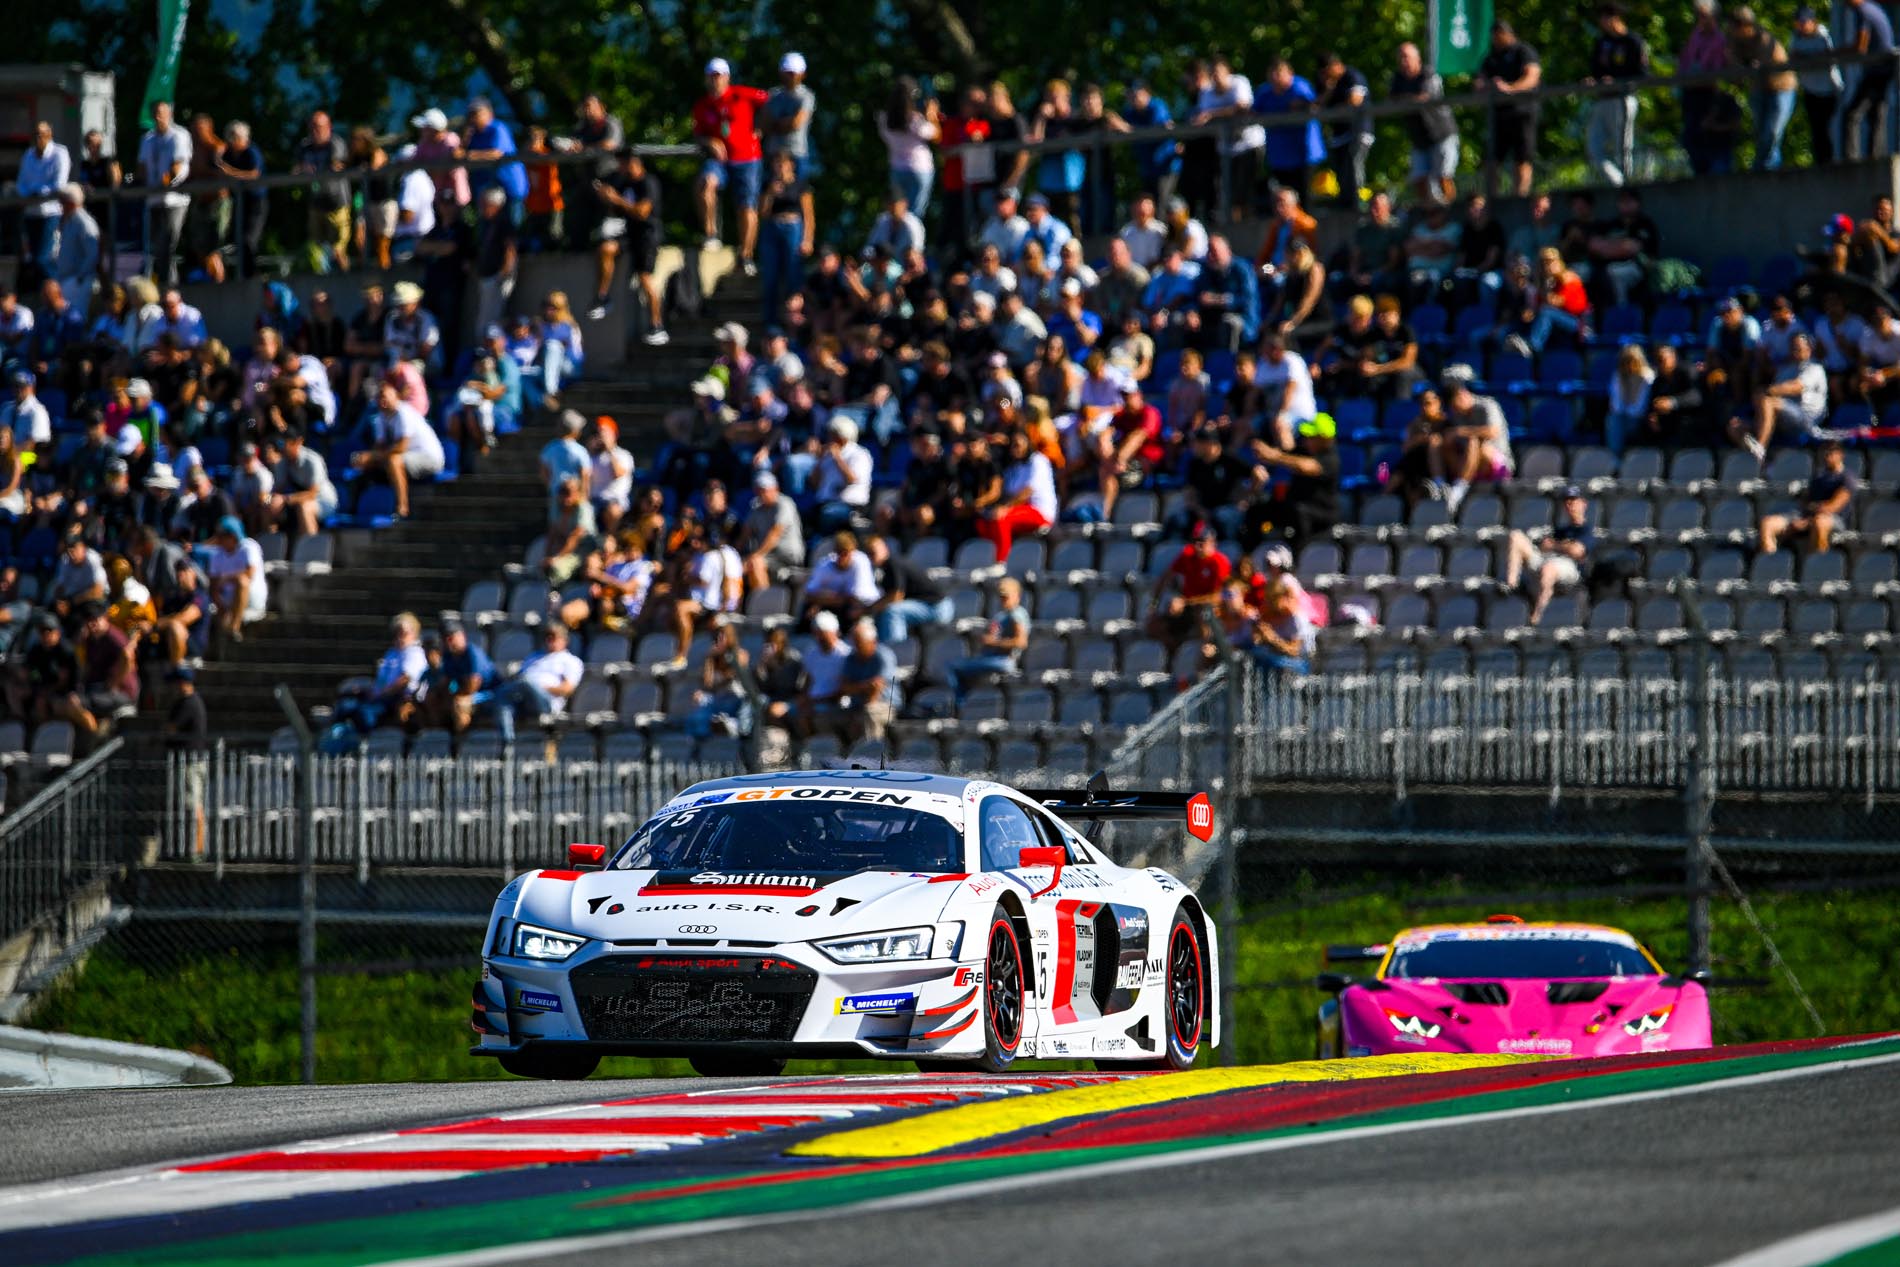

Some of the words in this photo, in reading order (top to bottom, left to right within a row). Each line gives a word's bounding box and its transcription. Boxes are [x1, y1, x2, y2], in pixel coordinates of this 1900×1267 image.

[635, 903, 698, 913] auto
[962, 971, 985, 984] R8
[526, 996, 559, 1008] MICHELIN
[856, 998, 907, 1009] MICHELIN
